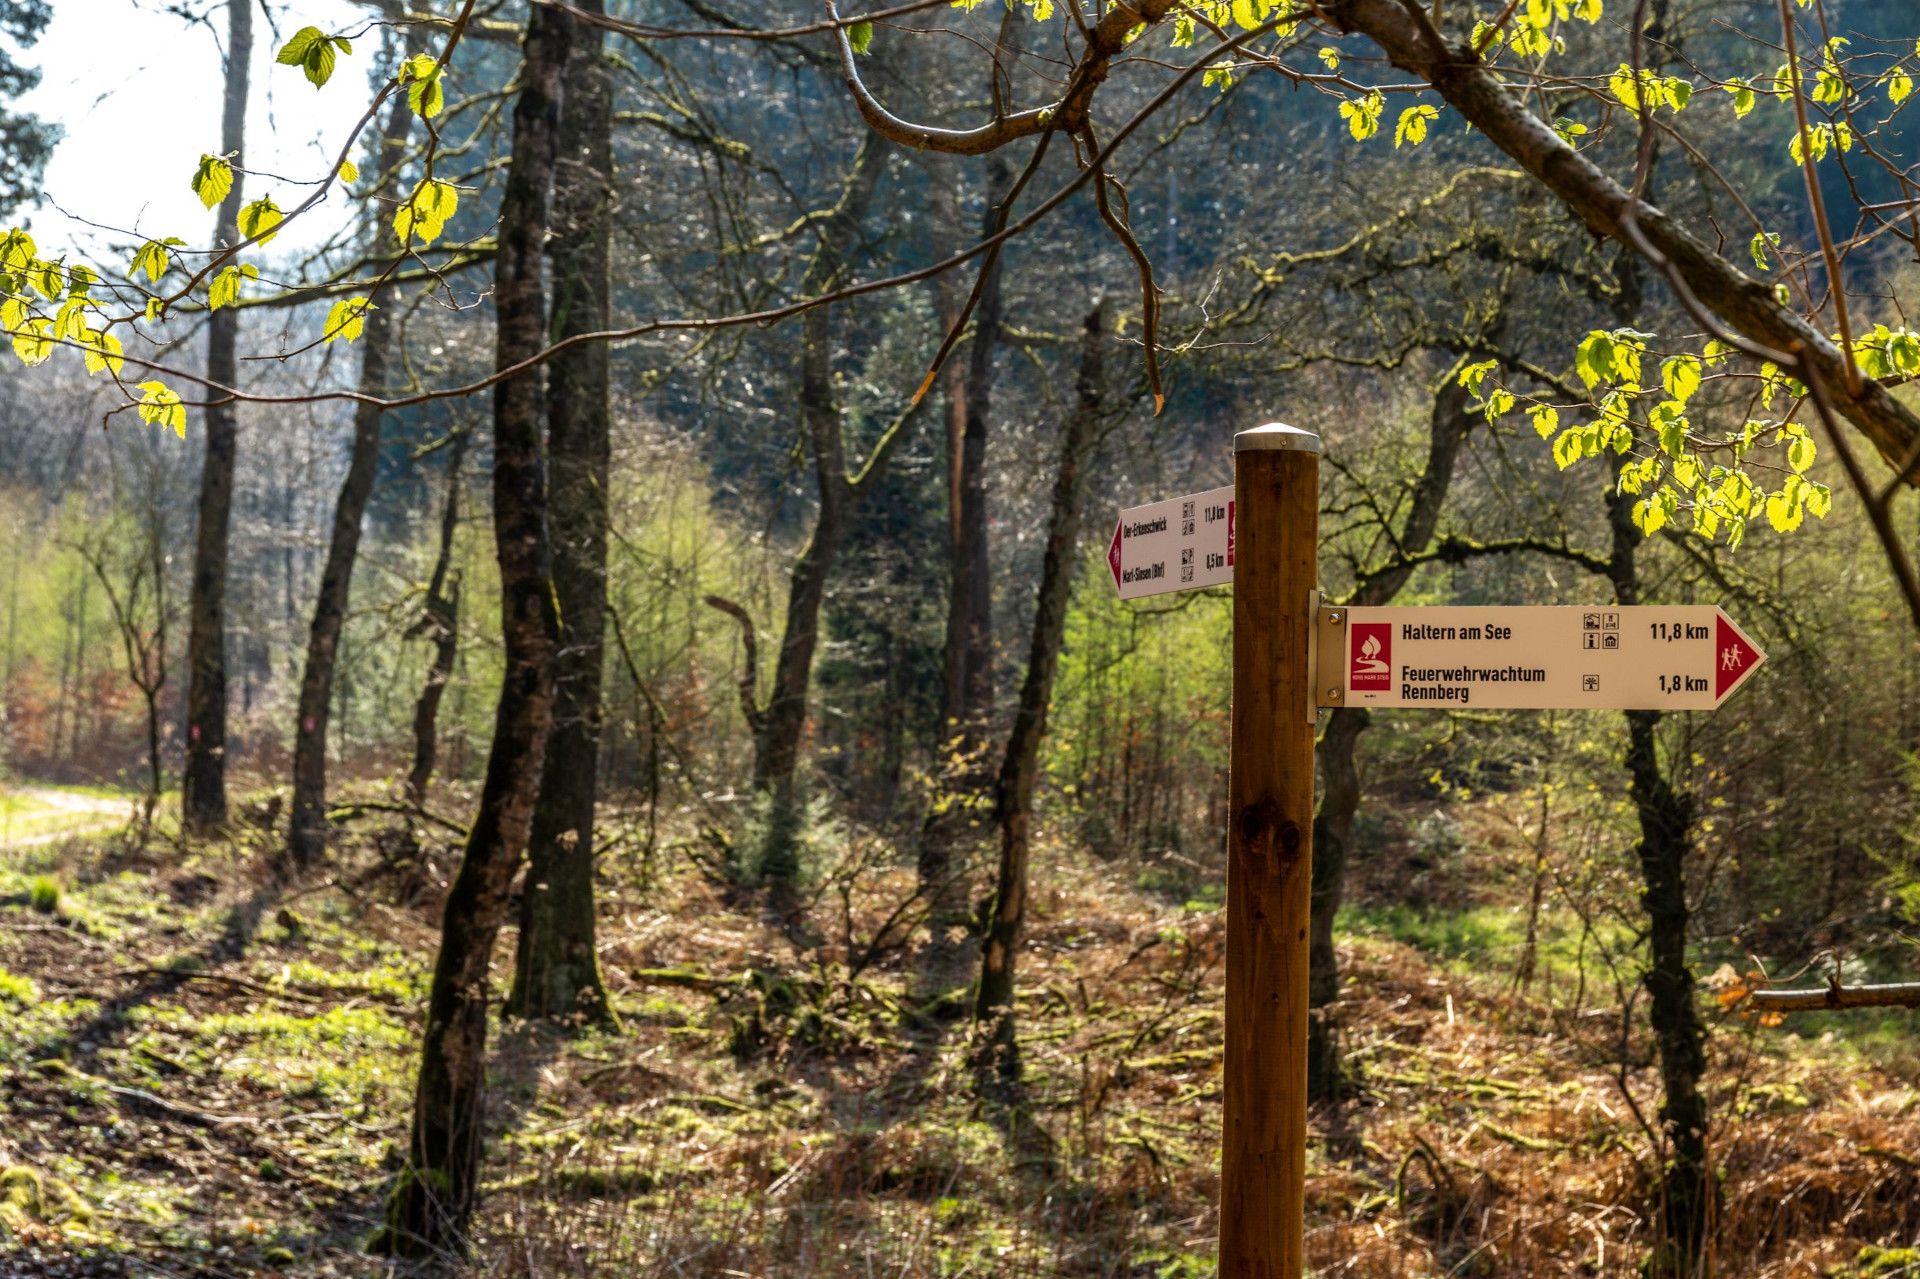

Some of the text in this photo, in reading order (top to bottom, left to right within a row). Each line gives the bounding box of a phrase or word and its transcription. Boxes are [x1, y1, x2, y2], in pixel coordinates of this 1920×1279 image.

[1217, 505, 1225, 520] km
[1216, 552, 1224, 567] km
[1402, 624, 1511, 640] Haltern am See
[1650, 623, 1708, 643] 11,8 km
[1402, 666, 1545, 682] Feuerwehrwachtum
[1659, 675, 1708, 694] 1,8 km
[1402, 684, 1469, 703] Rennberg
